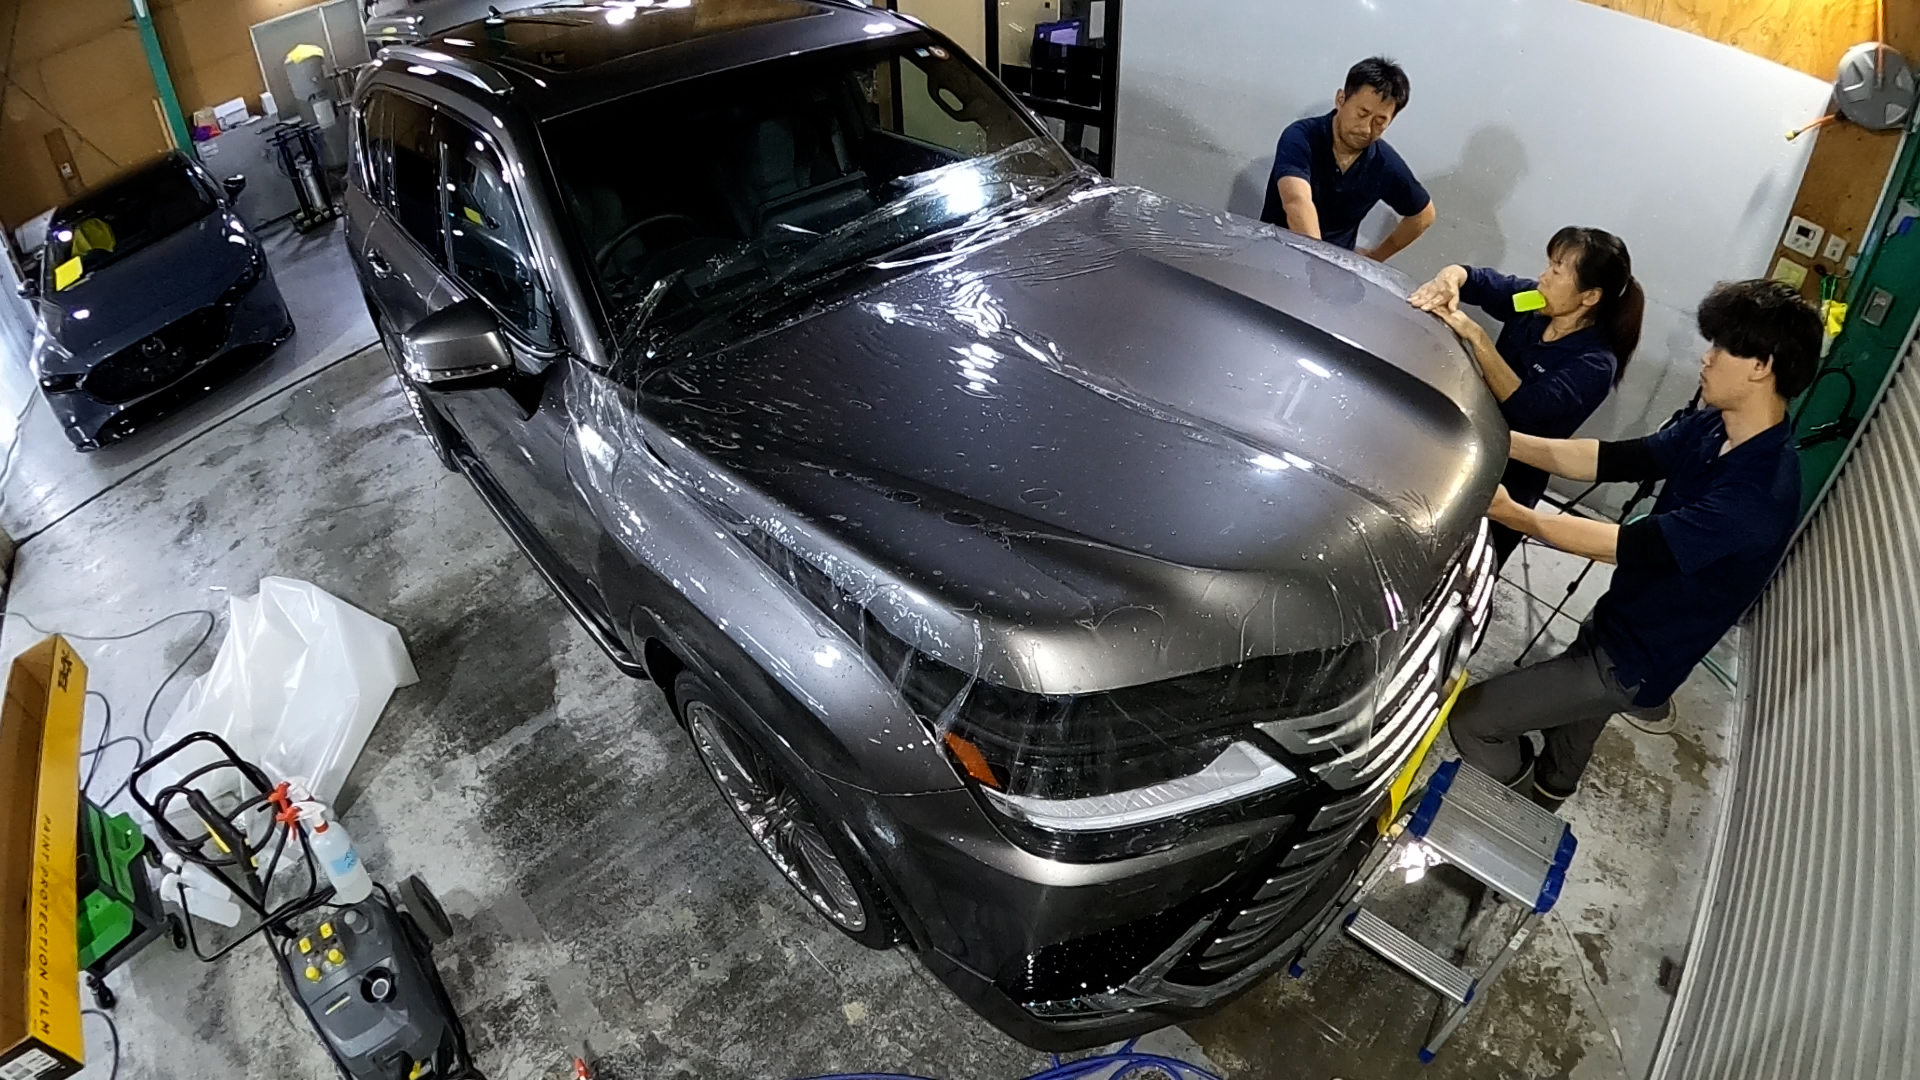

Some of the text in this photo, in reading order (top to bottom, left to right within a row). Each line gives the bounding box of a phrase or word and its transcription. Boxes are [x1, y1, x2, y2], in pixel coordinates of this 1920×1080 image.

[39, 814, 51, 1035] PAINT PROTECTION FILM
